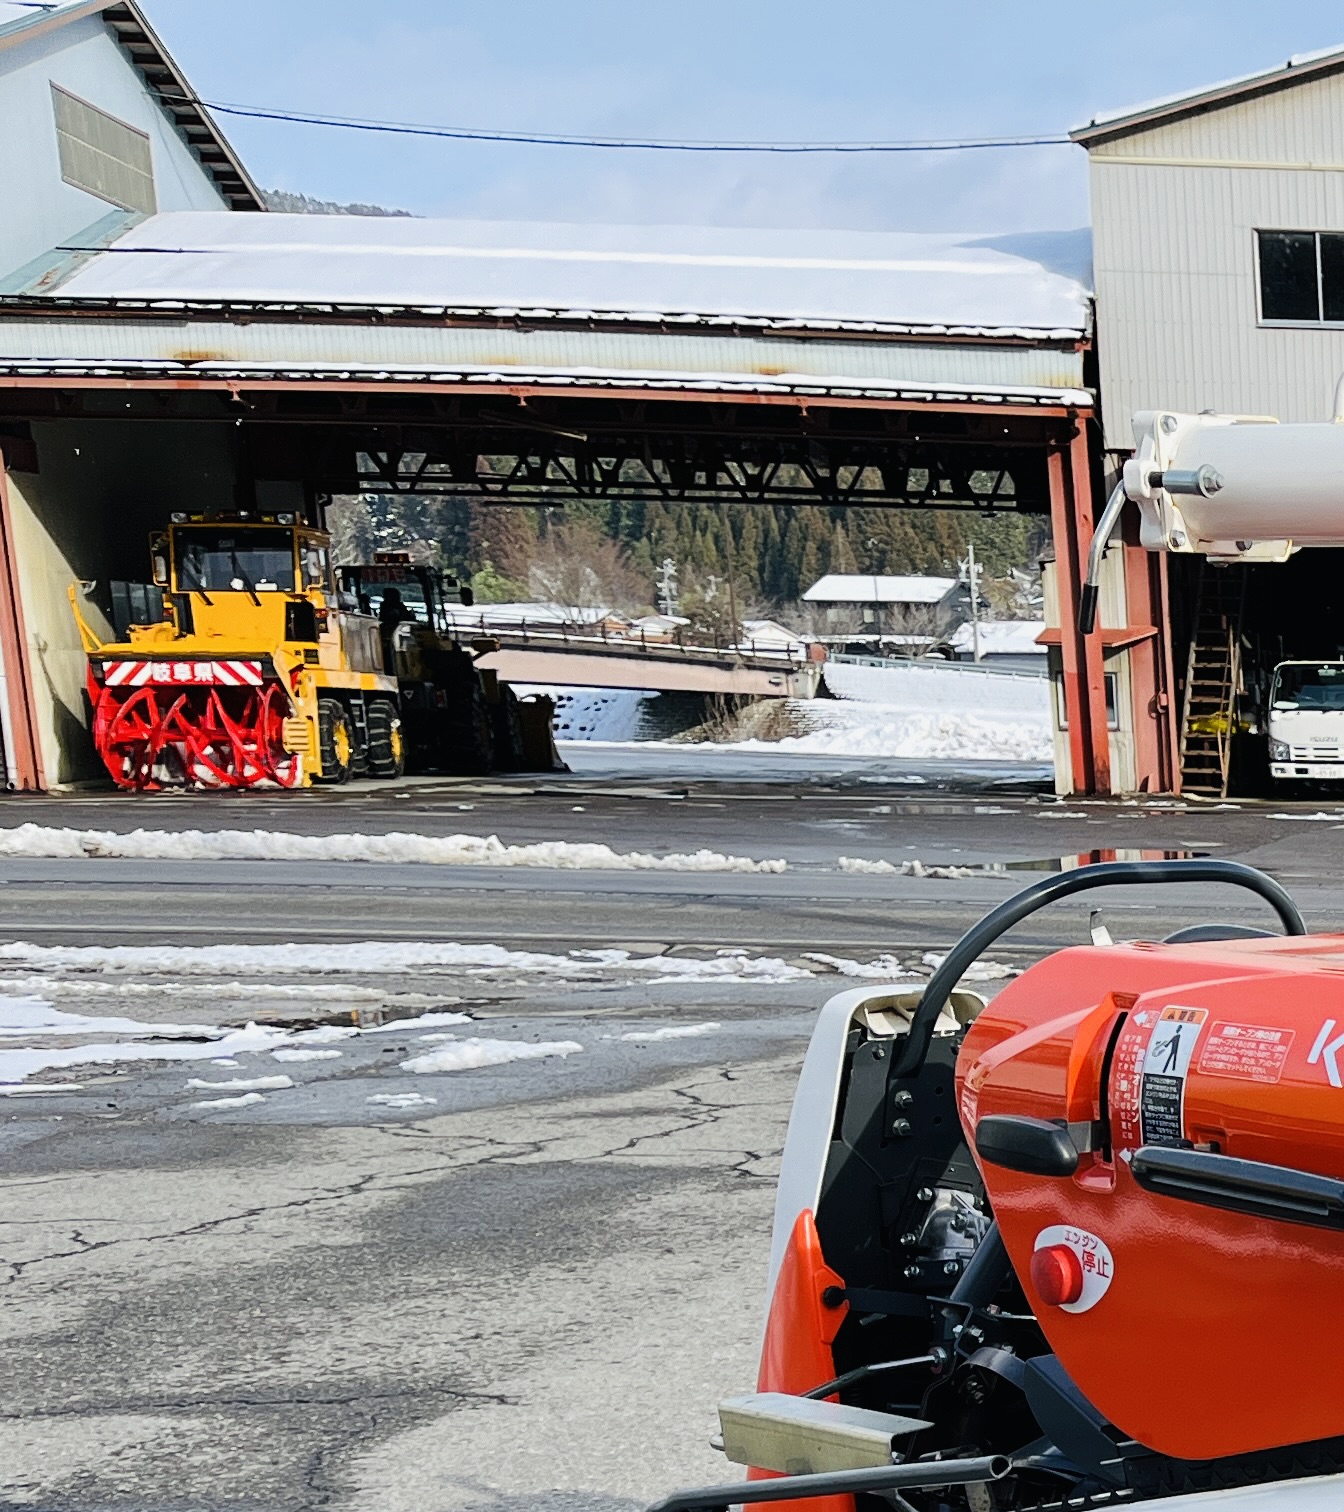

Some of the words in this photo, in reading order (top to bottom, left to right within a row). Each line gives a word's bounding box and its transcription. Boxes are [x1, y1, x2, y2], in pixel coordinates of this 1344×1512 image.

[152, 662, 214, 682] 岐阜県
[1064, 1230, 1098, 1250] エンジン
[1082, 1249, 1109, 1278] 停止
